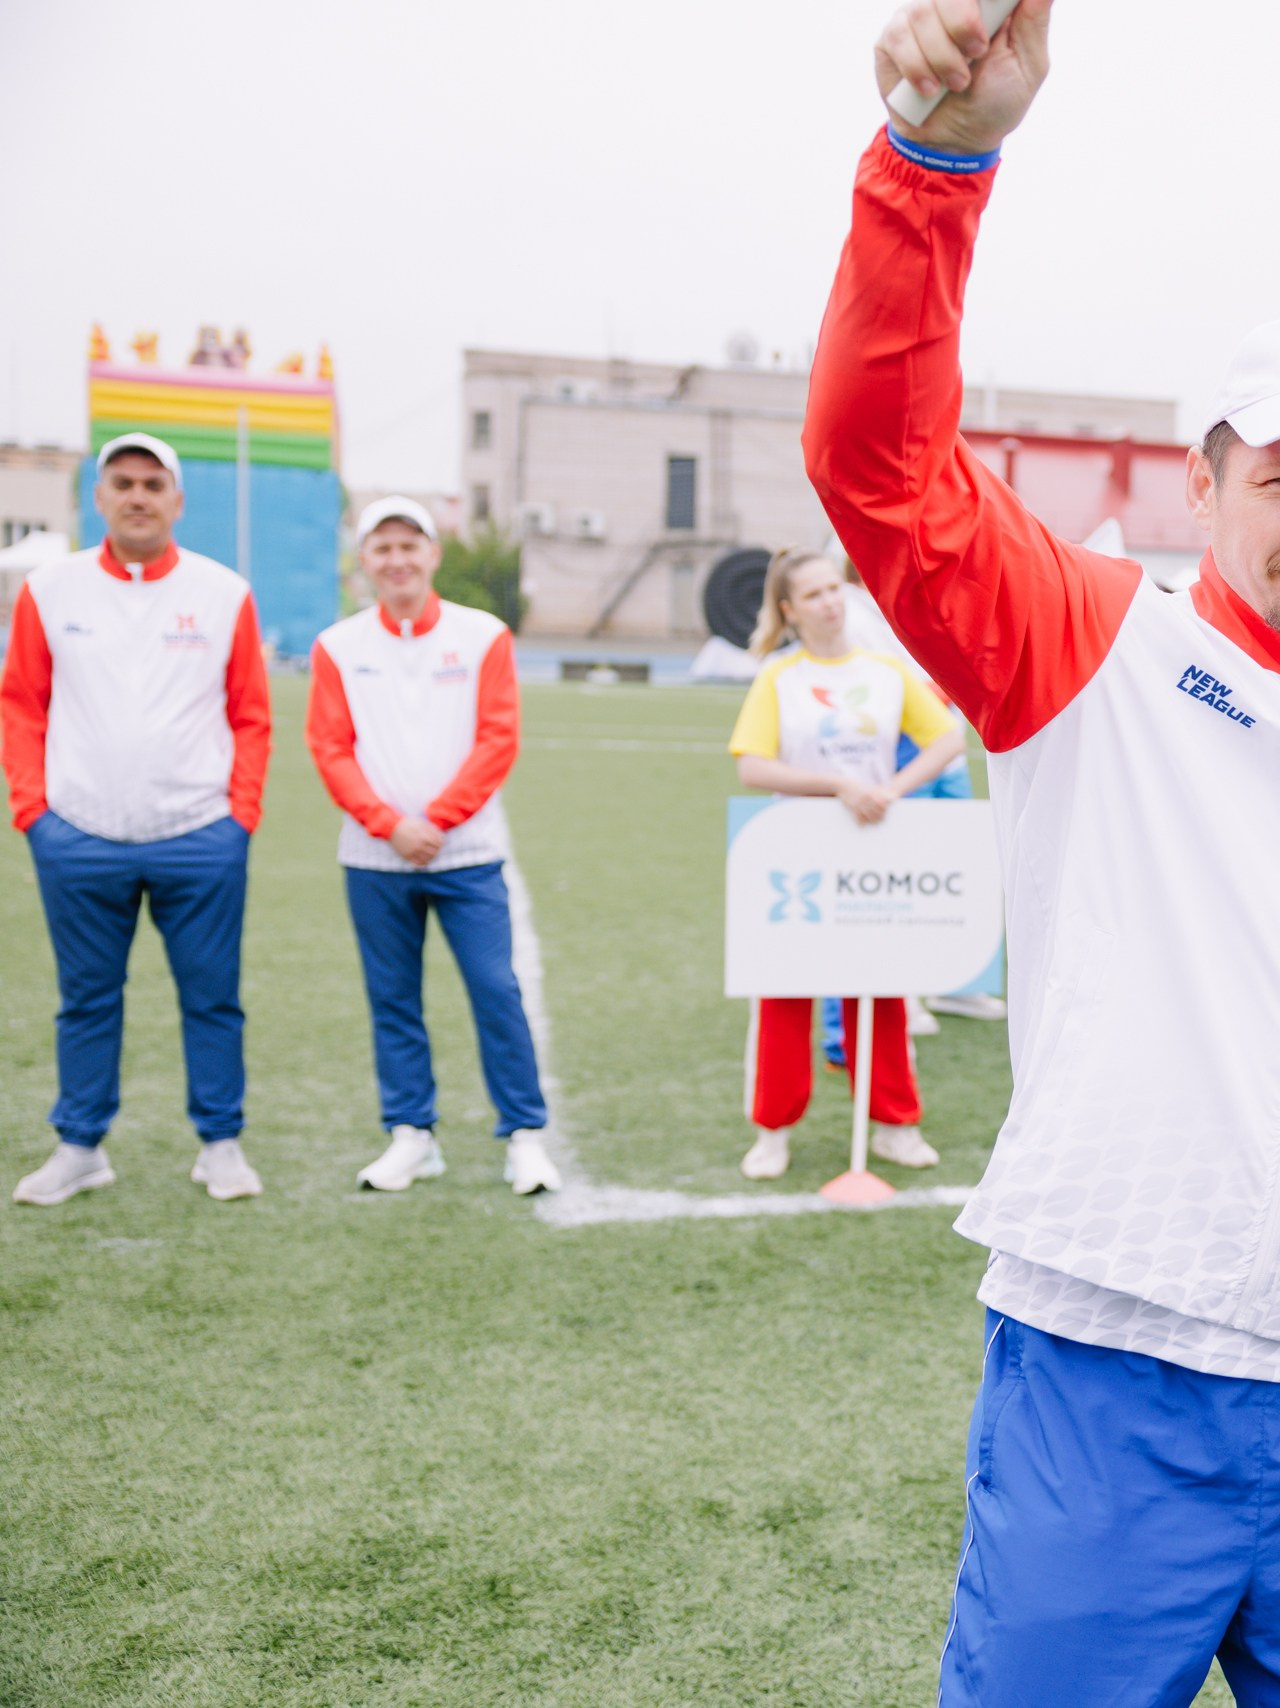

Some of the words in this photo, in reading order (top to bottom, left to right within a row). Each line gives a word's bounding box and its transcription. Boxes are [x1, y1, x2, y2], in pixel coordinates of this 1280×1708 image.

[1181, 664, 1233, 698] NEW
[1176, 678, 1256, 739] LEAGUE
[836, 871, 963, 896] КОМОС
